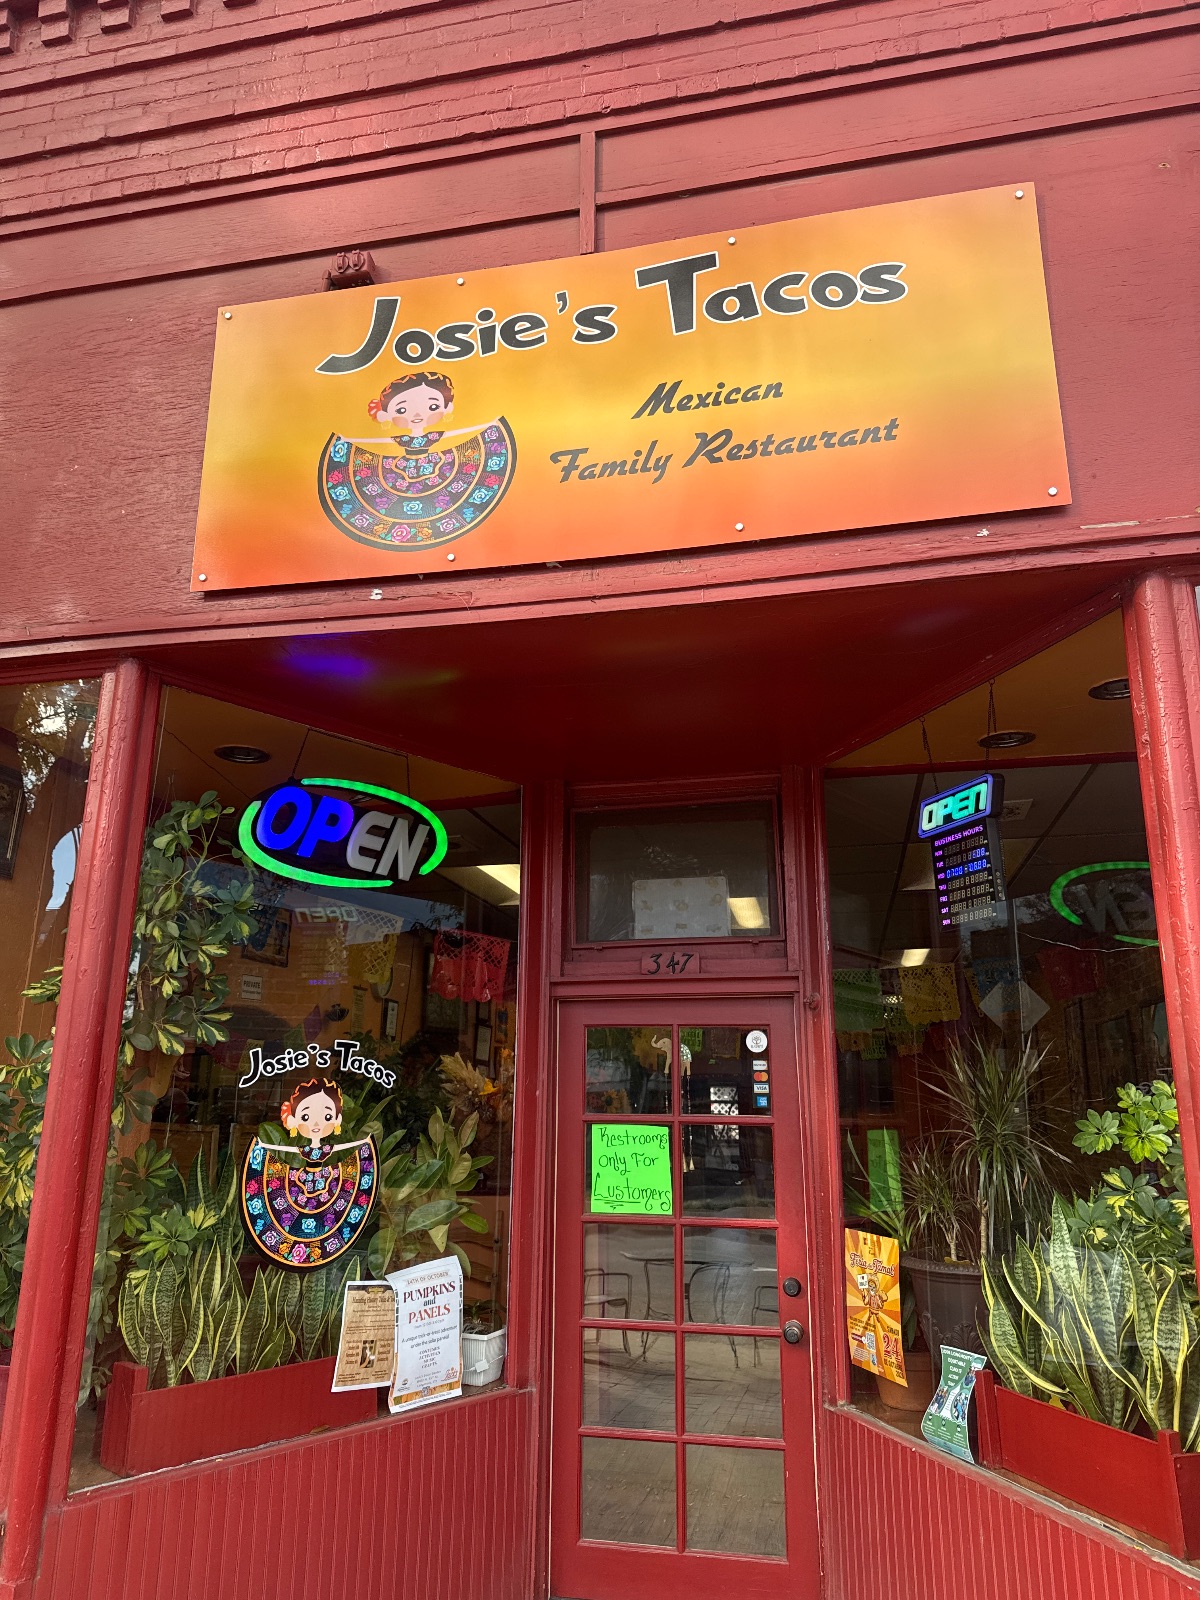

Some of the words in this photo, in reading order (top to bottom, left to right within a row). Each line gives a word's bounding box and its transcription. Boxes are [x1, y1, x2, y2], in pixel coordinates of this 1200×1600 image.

[315, 290, 617, 375] Josie's
[635, 251, 908, 335] Tacos
[631, 380, 783, 419] Mexican
[549, 440, 673, 484] Family
[682, 418, 899, 468] Restaurant
[922, 783, 988, 830] OPEN
[256, 786, 430, 881] OPEN
[934, 832, 962, 847] BUSINESS
[962, 824, 984, 837] HOURS
[647, 952, 694, 975] 347
[243, 980, 261, 989] PRIVATE
[239, 1043, 331, 1087] Josie's
[334, 1039, 396, 1089] Tacos
[598, 1126, 668, 1149] Restrooms
[598, 1152, 631, 1175] Only
[630, 1152, 659, 1167] For
[403, 1281, 456, 1303] PUMPKINS
[423, 1296, 436, 1307] and
[408, 1303, 451, 1324] PANELS
[883, 1332, 902, 1361] 24
